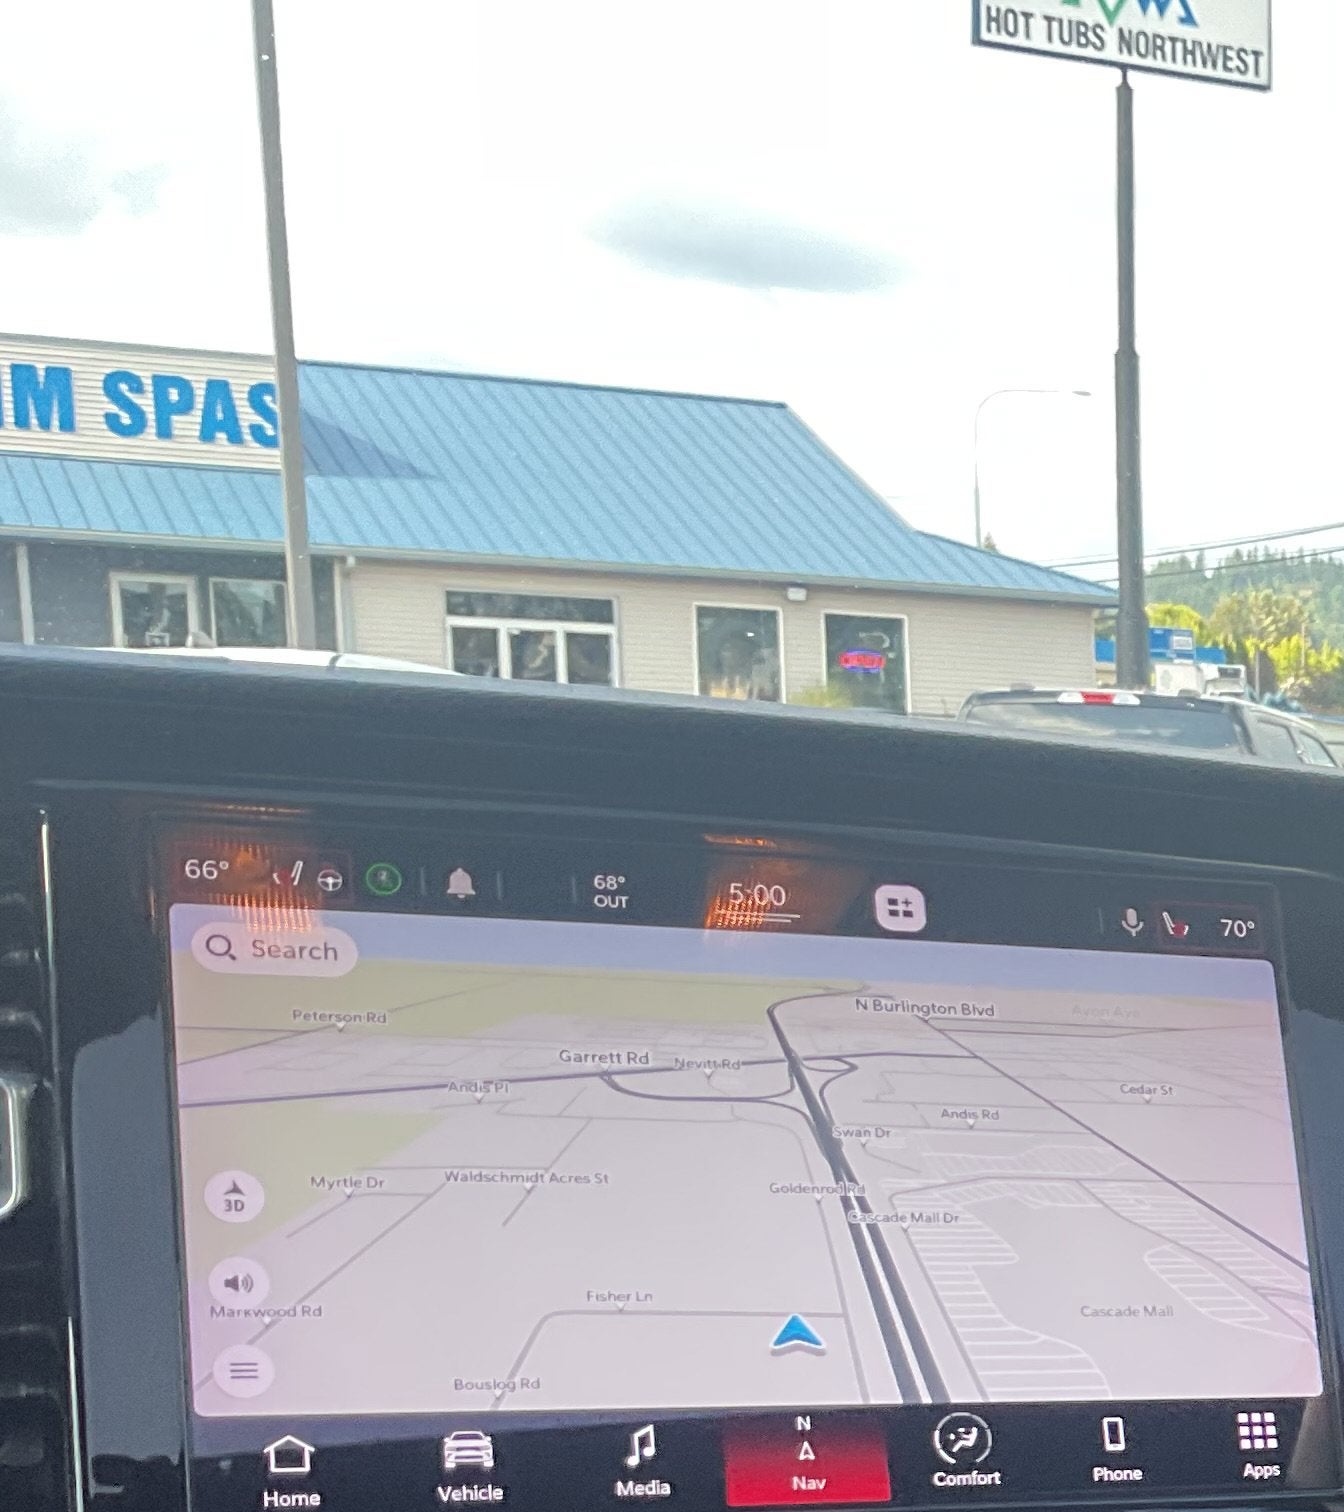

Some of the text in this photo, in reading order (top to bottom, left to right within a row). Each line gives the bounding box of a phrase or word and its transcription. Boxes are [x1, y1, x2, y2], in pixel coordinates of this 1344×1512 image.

[985, 5, 1264, 78] HOT TUBS NORTHWEST
[102, 370, 281, 448] SPAS
[593, 894, 630, 910] OUT
[251, 938, 339, 963] Search
[292, 1008, 388, 1025] Peterson Rd
[855, 998, 996, 1018] N Burlington Blvd
[559, 1048, 650, 1066] Garrett Rd
[448, 1079, 489, 1094] Andis
[1119, 1083, 1174, 1097] Cedar St
[941, 1107, 1000, 1121] Andis Rd
[833, 1126, 892, 1140] Swan Dr
[311, 1174, 386, 1192] Myrtle Dr
[444, 1169, 610, 1186] Waldschmidt Acres St
[769, 1181, 845, 1196] Goldenrod
[223, 1197, 246, 1213] 3D
[847, 1210, 960, 1226] Cascade Mall Dr
[586, 1290, 653, 1304] Fisher Ln
[210, 1304, 323, 1320] Markwood Rd
[1080, 1304, 1174, 1320] Cascade Mall
[453, 1376, 541, 1394] Bouslog Rd
[932, 1469, 1002, 1489] Comfort
[1092, 1465, 1144, 1484] Phone
[1243, 1460, 1282, 1482] Apps
[615, 1478, 672, 1498] Media
[791, 1474, 827, 1493] Nav
[262, 1488, 321, 1509] Home
[437, 1483, 504, 1504] Vehicle
